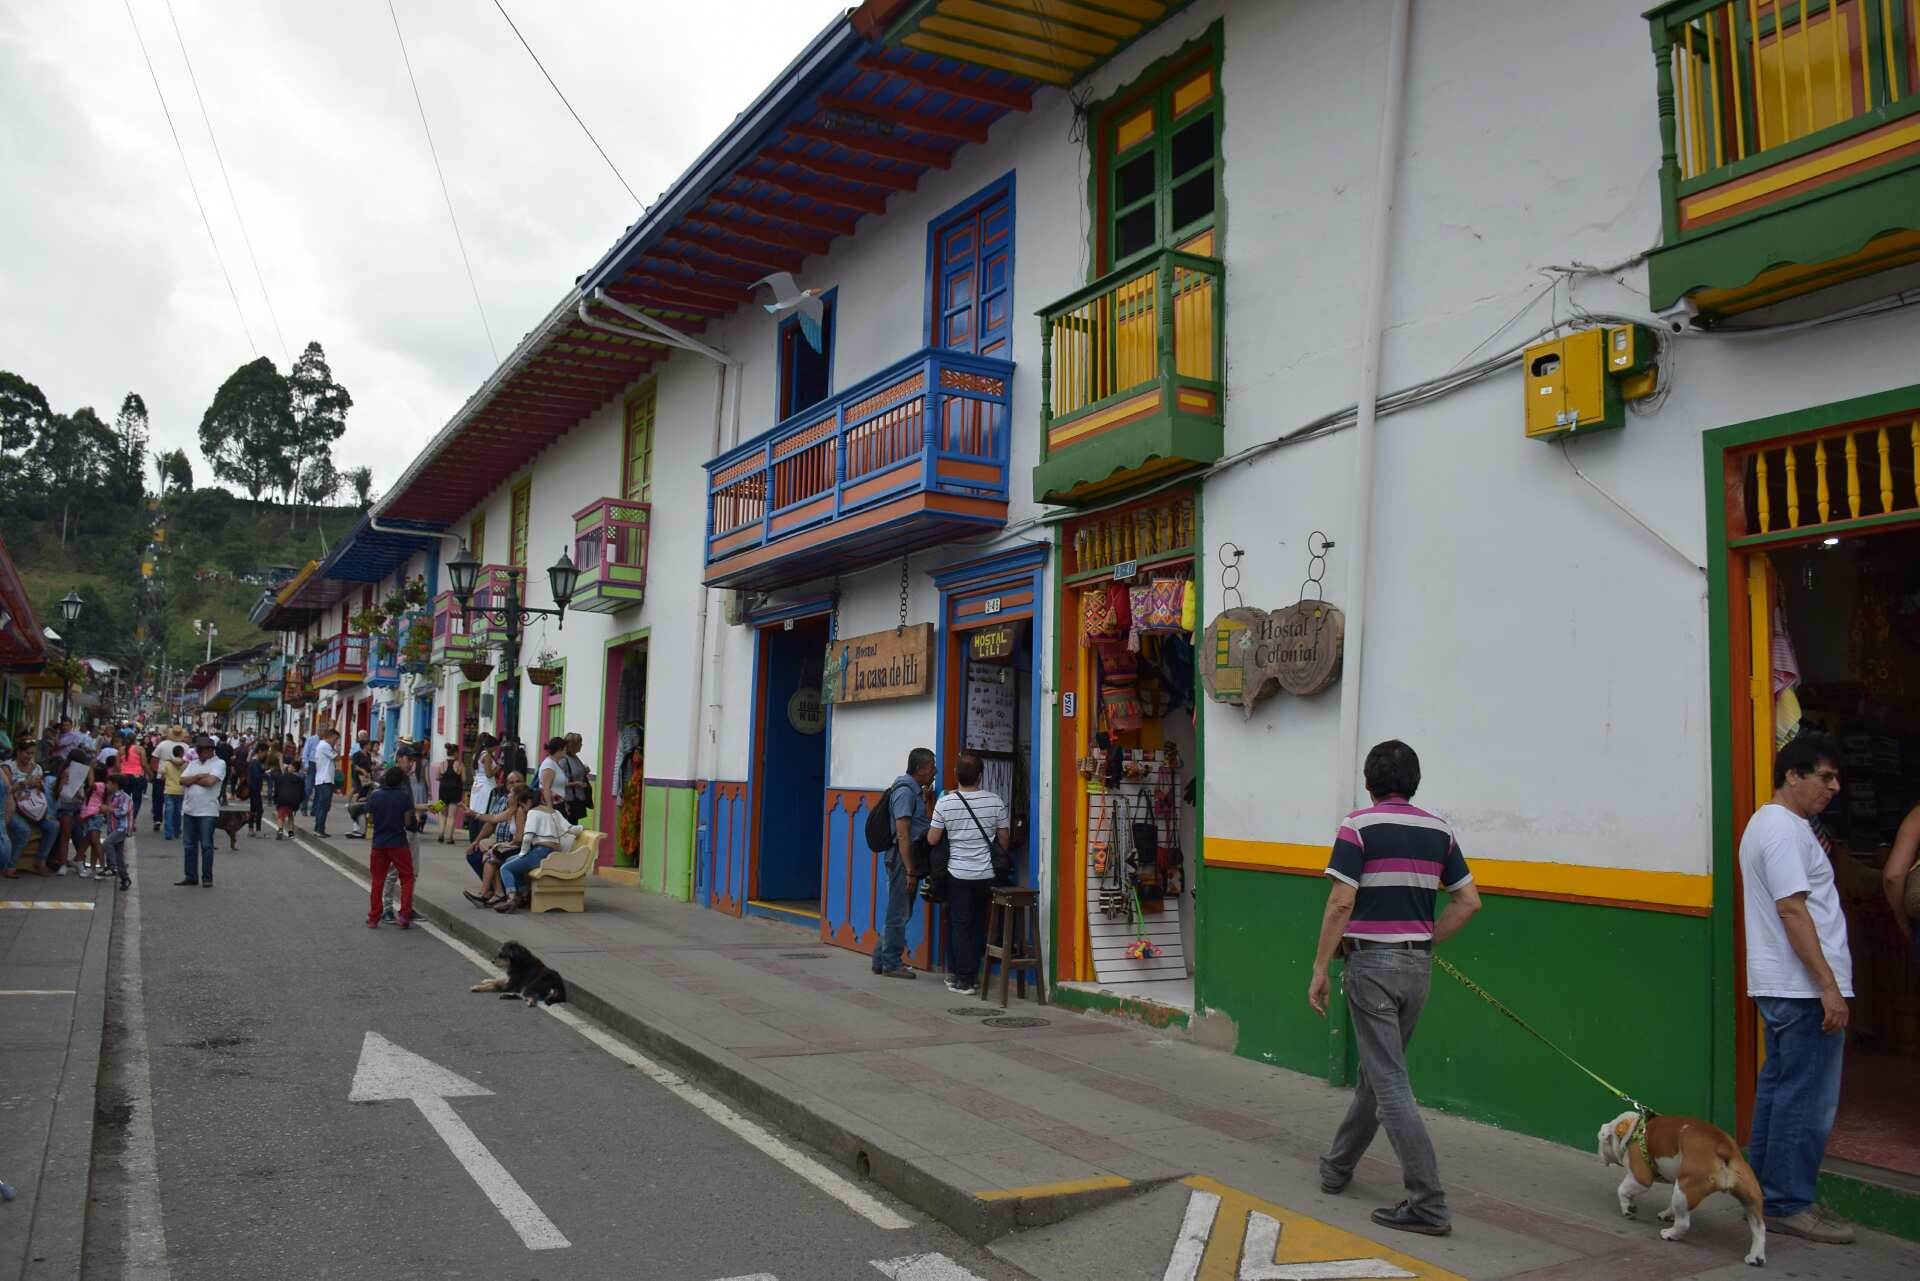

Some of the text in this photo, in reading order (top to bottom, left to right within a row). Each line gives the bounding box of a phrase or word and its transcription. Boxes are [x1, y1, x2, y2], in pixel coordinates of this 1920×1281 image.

[974, 631, 1008, 648] HOSTAL
[1256, 617, 1309, 640] Hostal
[1255, 640, 1319, 668] Colonial
[866, 667, 888, 689] casa
[889, 655, 901, 687] de
[1064, 693, 1072, 714] VISA
